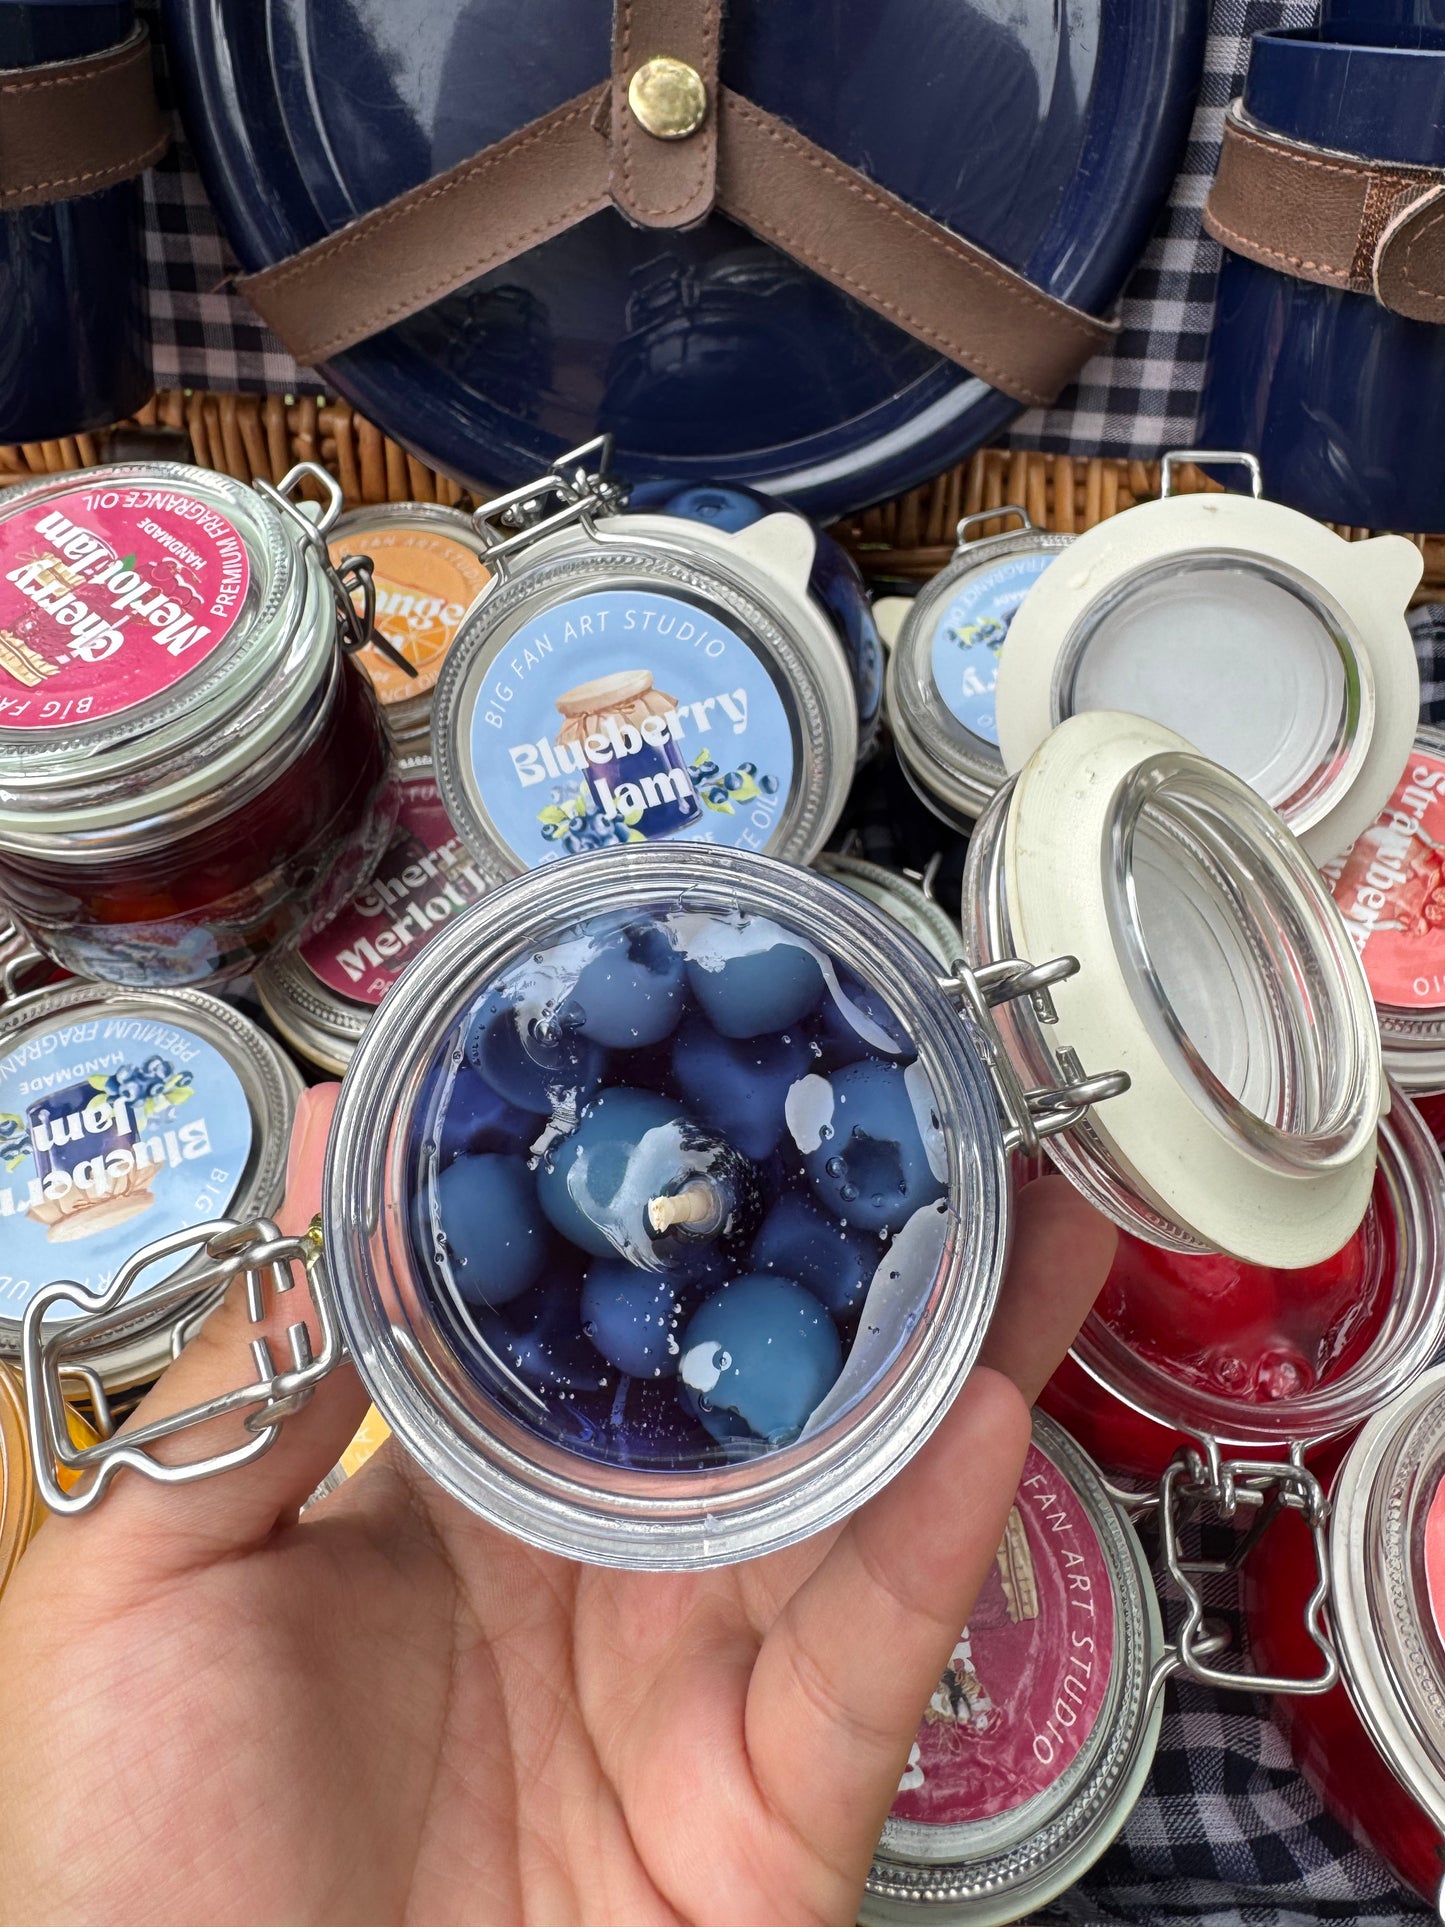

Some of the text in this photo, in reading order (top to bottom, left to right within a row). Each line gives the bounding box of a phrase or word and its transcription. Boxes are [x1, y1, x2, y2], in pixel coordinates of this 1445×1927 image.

[34, 510, 212, 657] Merlot Jam
[81, 490, 244, 619] PREMIUM FRAGRANCE OIL
[137, 517, 207, 570] HANDMADE
[5, 567, 126, 663] Cherry
[0, 696, 94, 720] BIG FA
[484, 609, 726, 730] BIG FAN ART STUDIO
[508, 687, 748, 788] Blueberry
[594, 767, 692, 820] Jam
[751, 793, 780, 831] OIL
[353, 836, 462, 917] Cherr
[1346, 766, 1445, 956] Strawberr
[335, 882, 467, 983] Merlot
[0, 1019, 201, 1081] PREMIUM FRAGRAN
[18, 1050, 125, 1096] HANDMADE
[0, 1117, 212, 1217] Blueberr
[32, 1096, 133, 1154] Jam
[194, 1166, 230, 1214] BIG
[1023, 1474, 1096, 1765] FAN ART STUDIO
